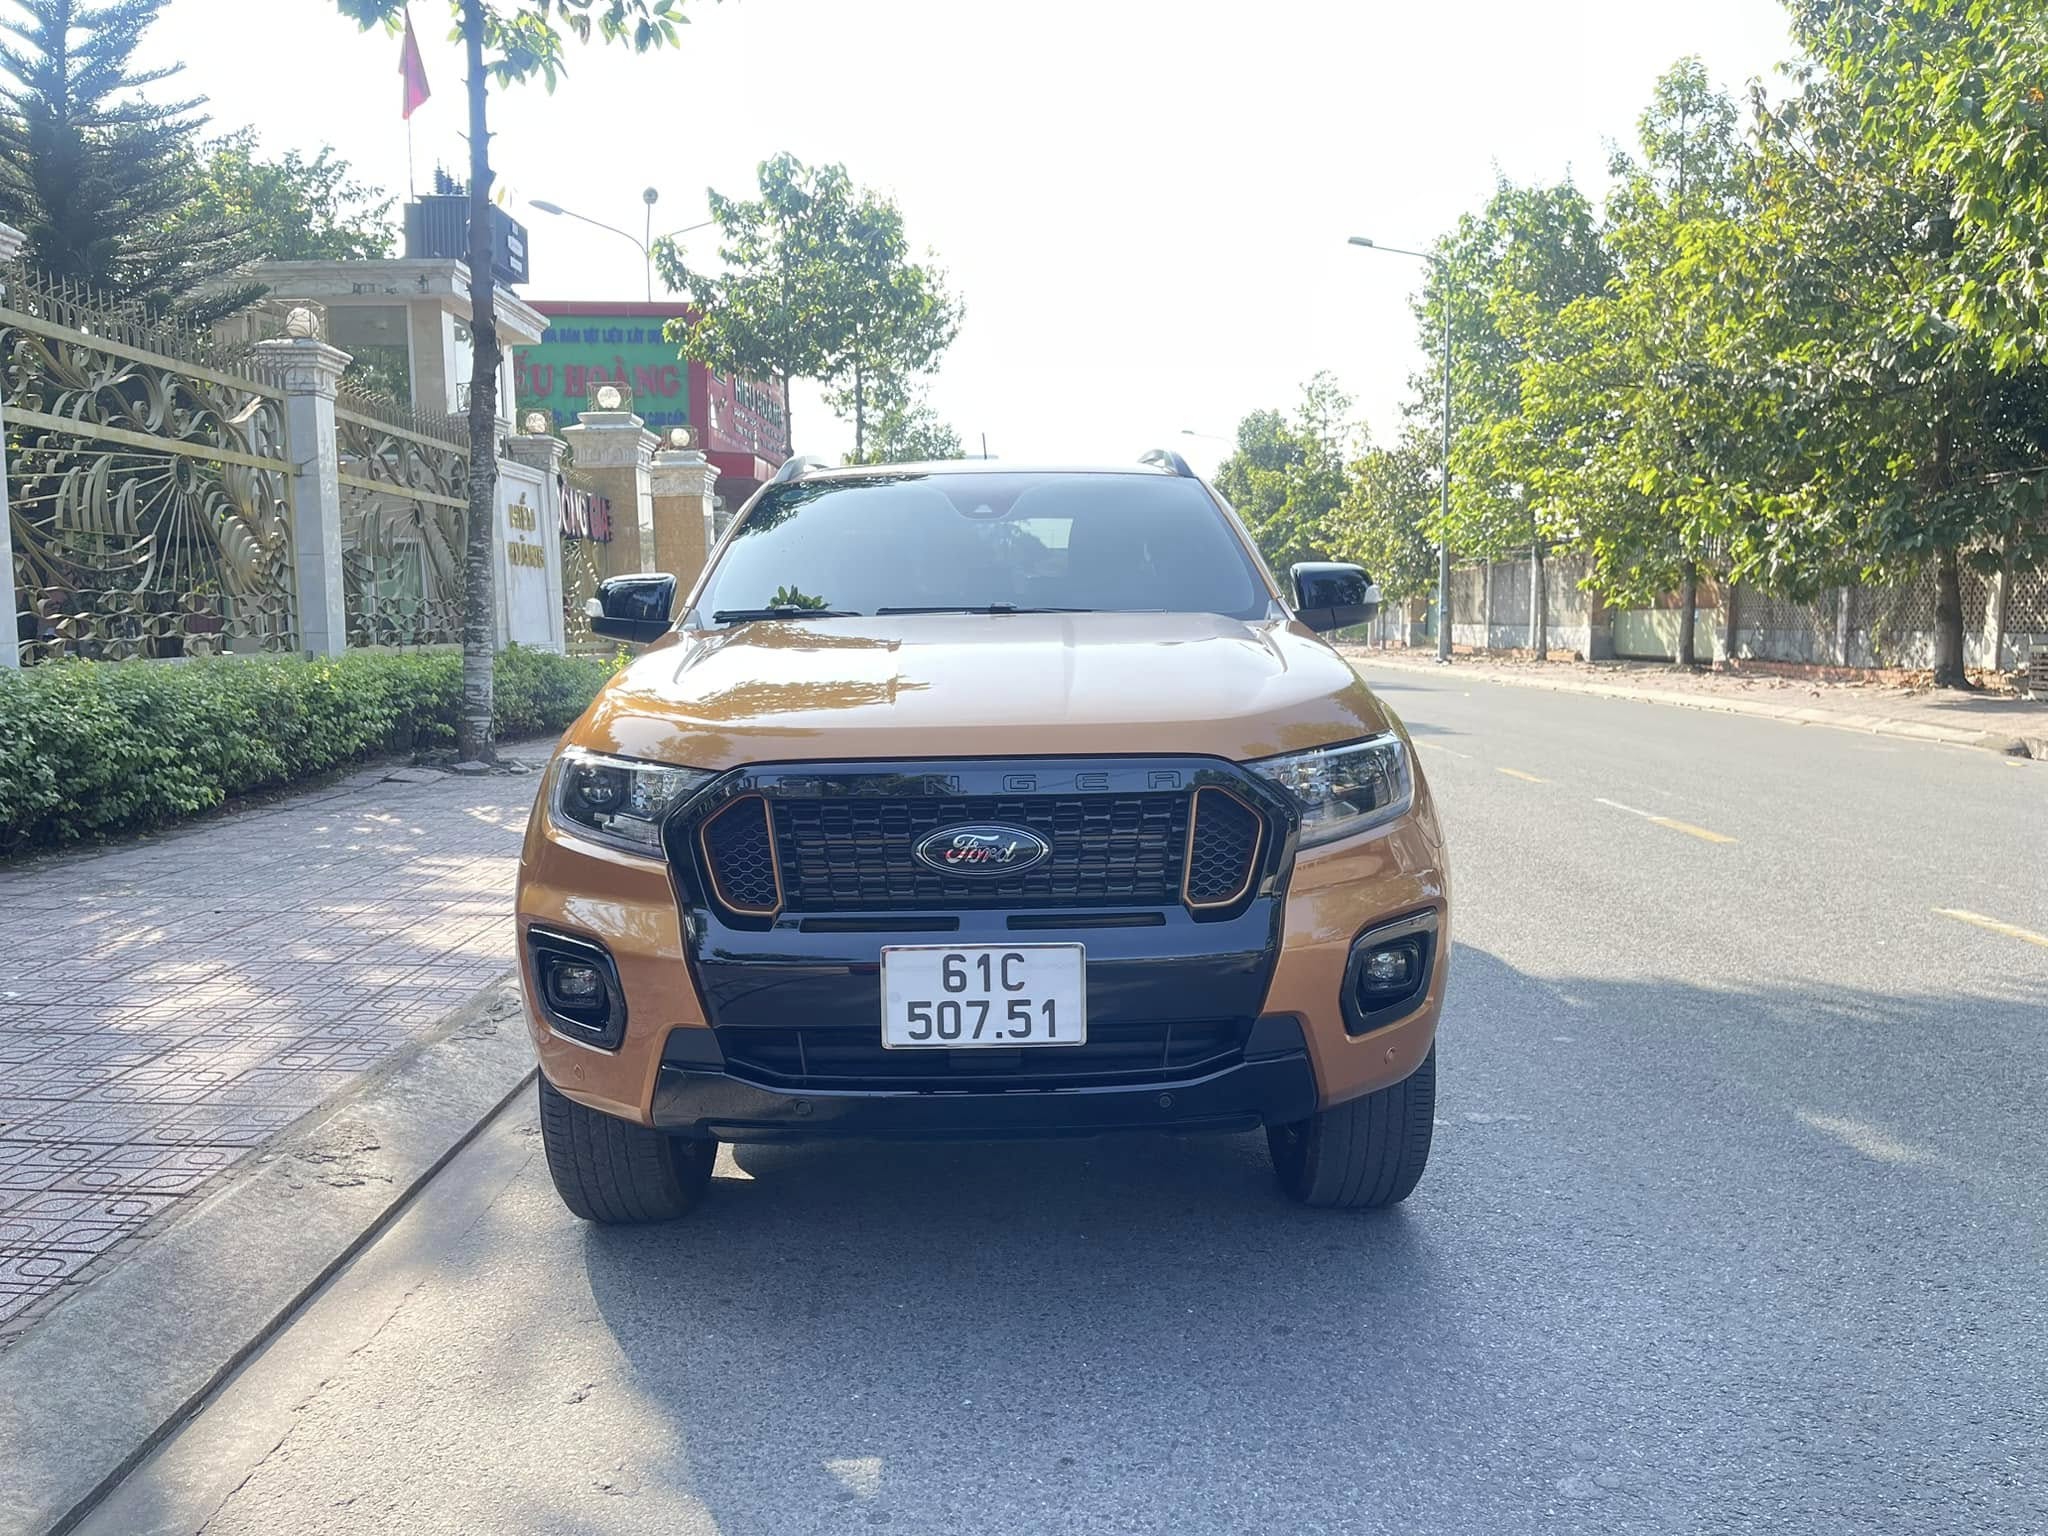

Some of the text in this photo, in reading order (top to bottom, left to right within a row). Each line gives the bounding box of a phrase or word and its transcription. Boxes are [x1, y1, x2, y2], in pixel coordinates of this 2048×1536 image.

[944, 834, 1017, 864] Ford
[942, 953, 1025, 993] 61C
[907, 998, 1056, 1040] 507.51
